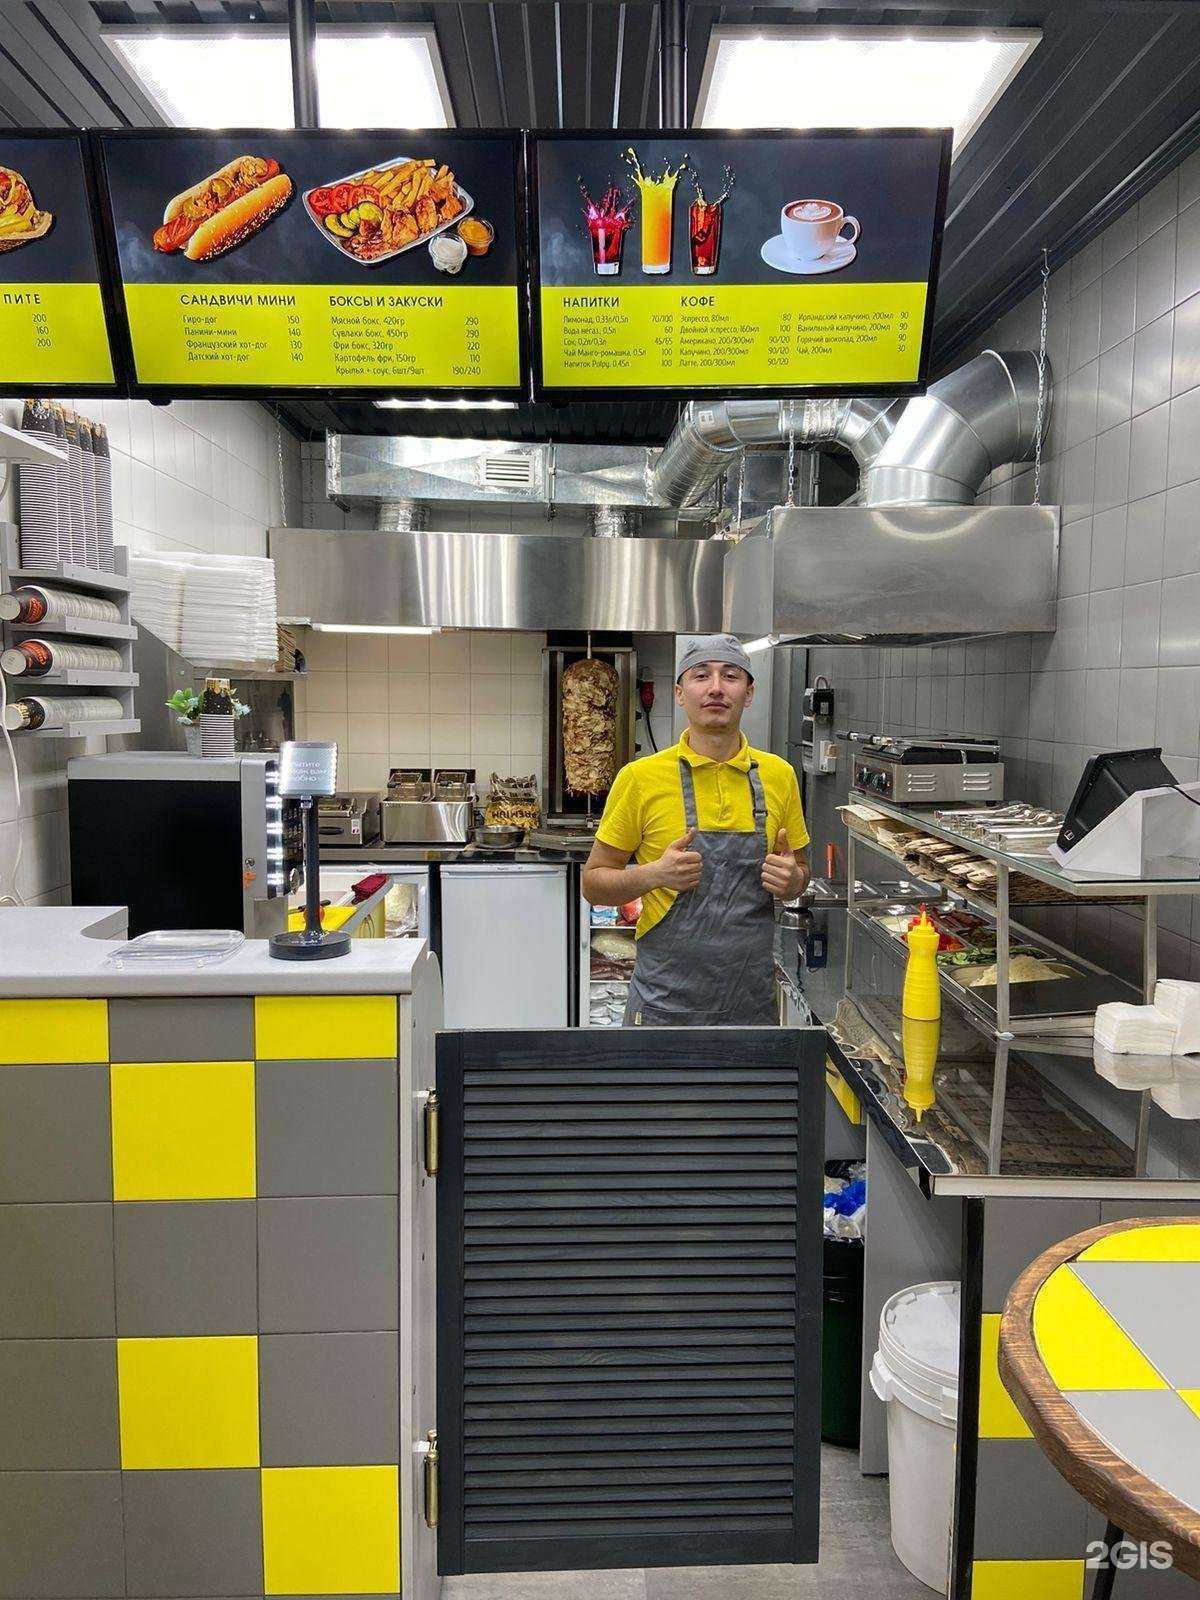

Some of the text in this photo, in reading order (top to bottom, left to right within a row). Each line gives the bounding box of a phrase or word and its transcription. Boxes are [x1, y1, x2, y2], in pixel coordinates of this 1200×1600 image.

[4, 293, 41, 305] ПИТЕ
[180, 294, 296, 306] САНДВИЧИ МИНИ
[329, 296, 443, 307] БОКСЫ И ЗАКУСКИ
[563, 297, 619, 307] НАПИТКИ
[681, 296, 715, 307] КОФЕ
[33, 313, 48, 323] 200
[183, 315, 300, 325] Гиро-дог 150
[331, 315, 361, 325] Мясной
[383, 316, 405, 326] 420гр
[465, 316, 479, 325] 290
[184, 328, 301, 337] Панини-мини 140
[332, 329, 363, 339] Сувлаки
[386, 329, 408, 339] 450гр
[466, 329, 480, 338] 290
[563, 327, 579, 335] Вода
[680, 326, 708, 334] Двойной
[37, 338, 52, 348] 200
[186, 340, 303, 351] Французский хот-дог 130
[333, 341, 350, 351] Фри
[372, 341, 394, 351] 320гр
[467, 342, 480, 350] 220
[188, 352, 304, 362] Датский хот-дог 140
[334, 353, 375, 363] Картофель
[395, 354, 416, 363] 150гр
[470, 354, 481, 363] 110
[336, 365, 363, 375] Крылья
[452, 366, 481, 375] 190/240
[491, 810, 538, 819] PREMIUM
